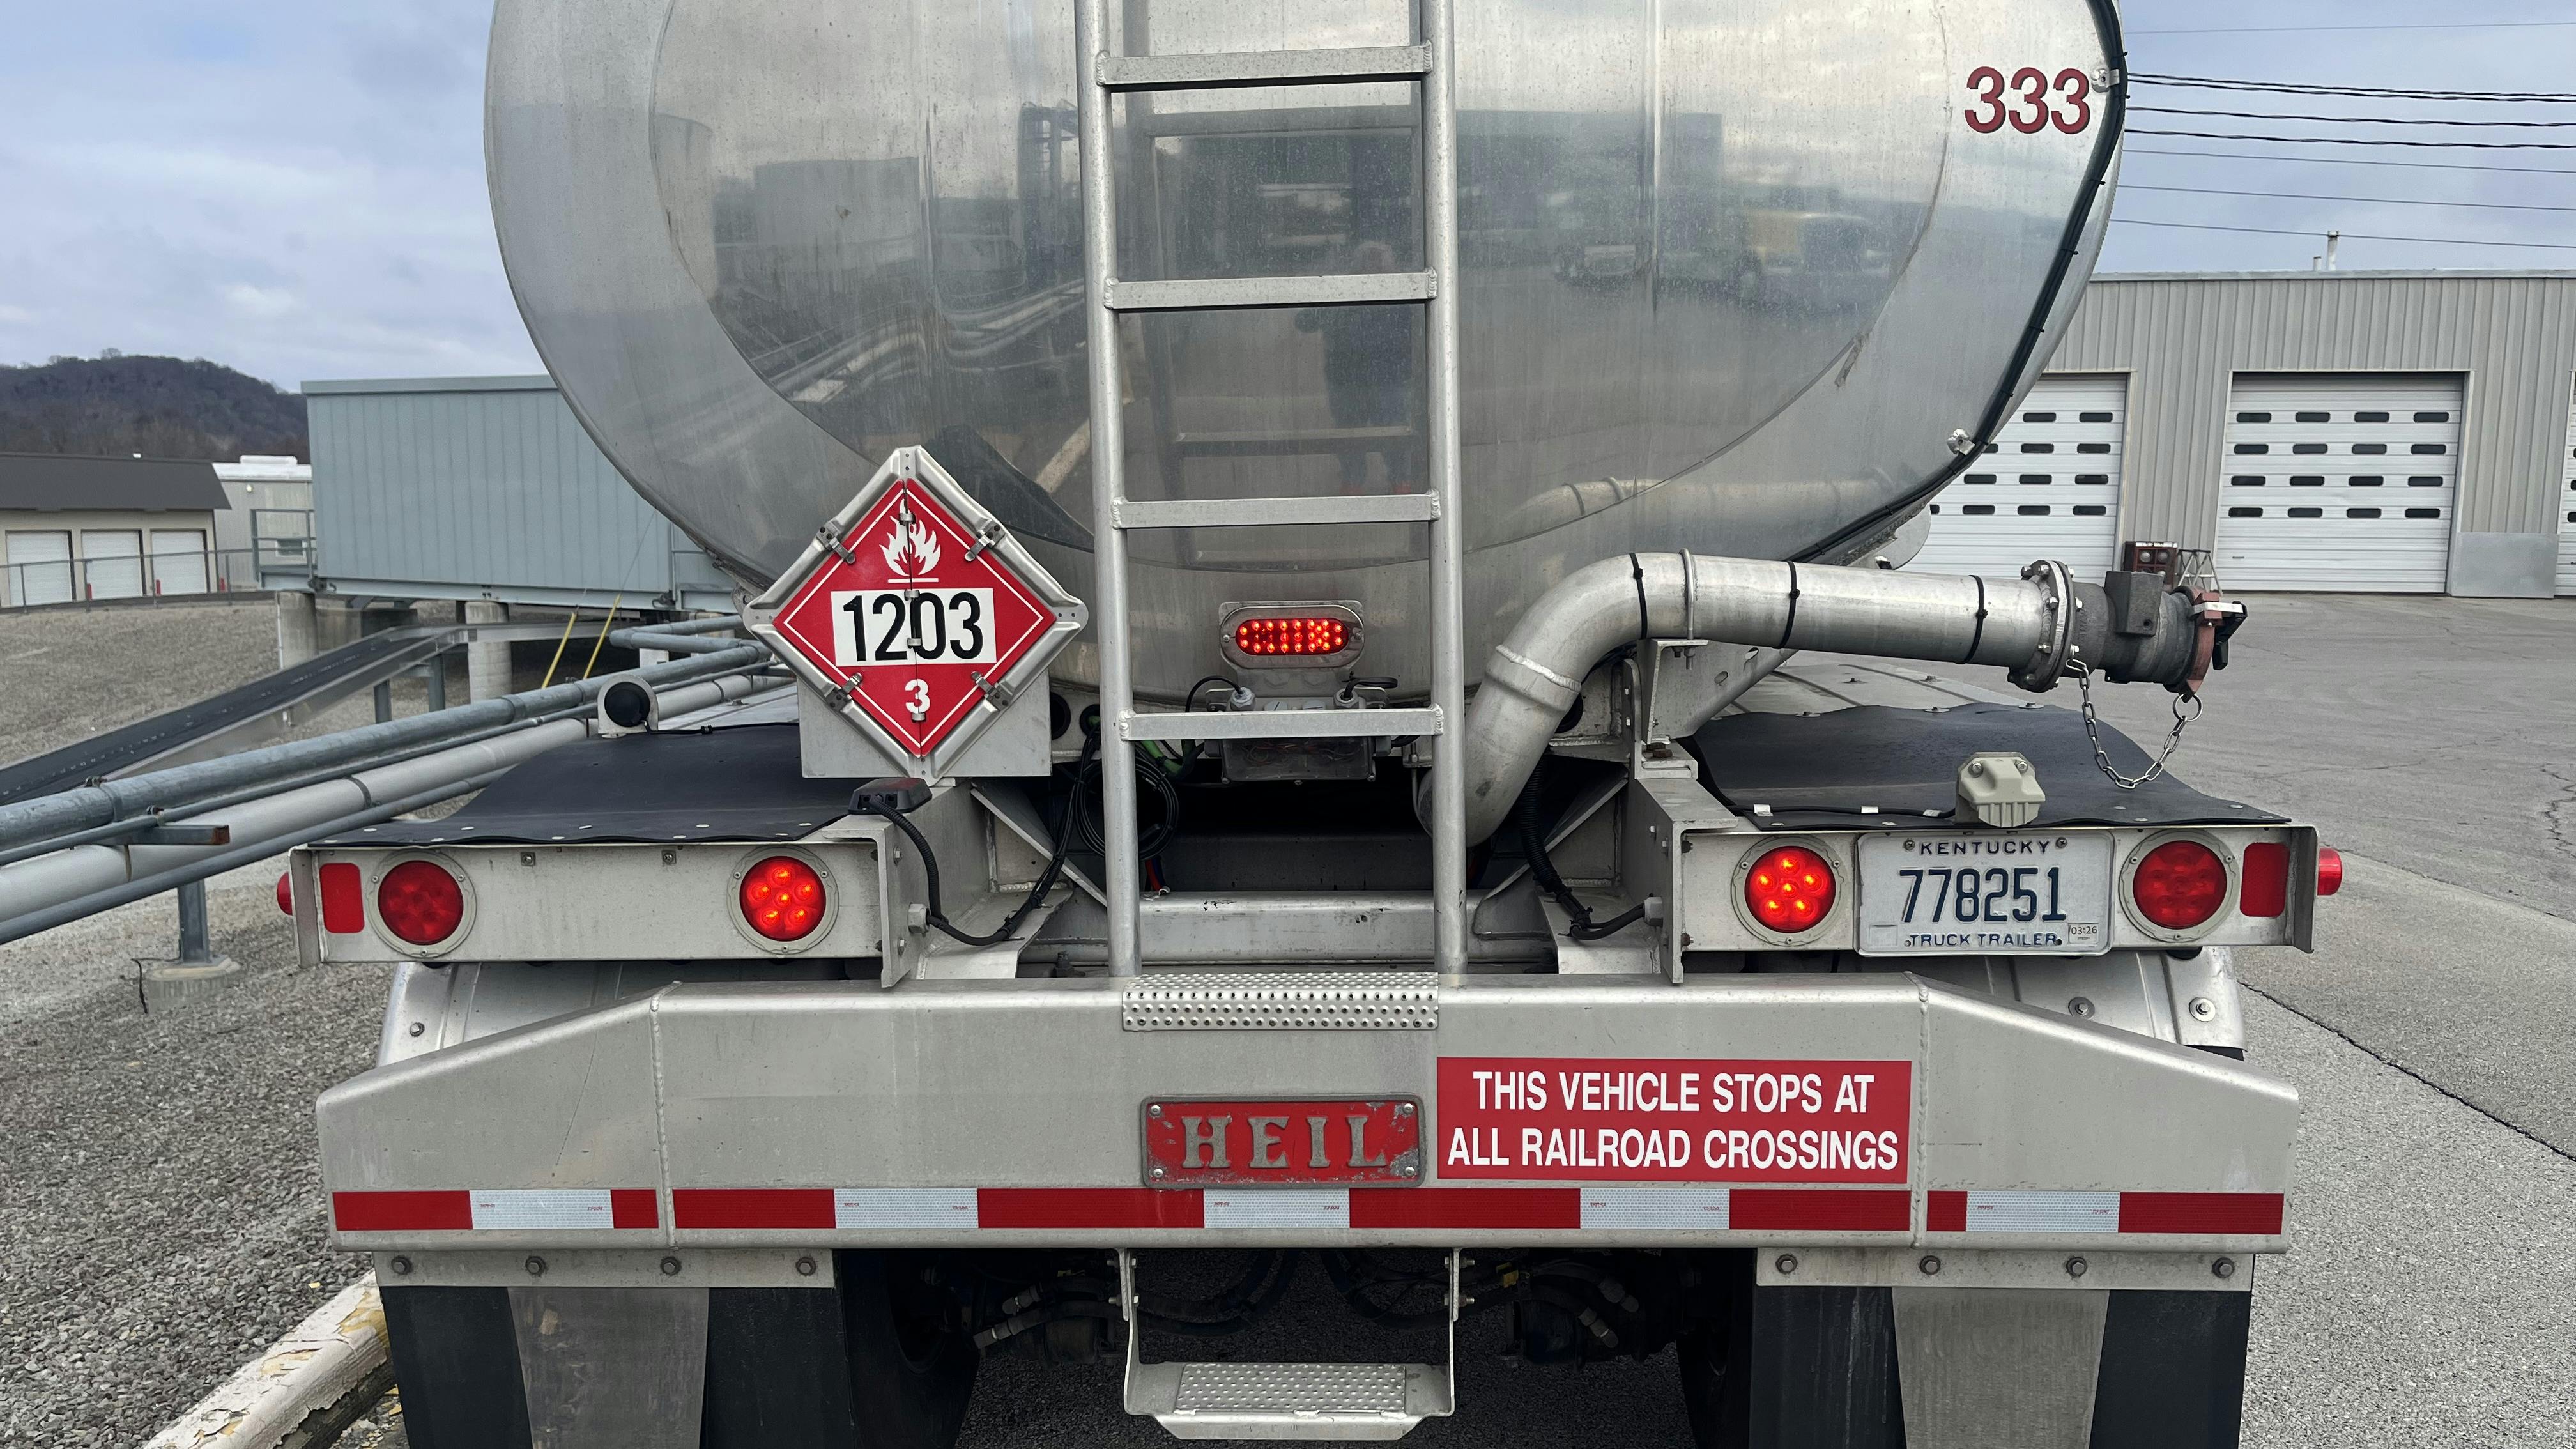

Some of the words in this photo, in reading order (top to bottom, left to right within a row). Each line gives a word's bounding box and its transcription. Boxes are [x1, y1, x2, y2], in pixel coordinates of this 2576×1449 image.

[1965, 66, 2091, 134] 333
[843, 592, 983, 662] 1203
[905, 679, 931, 714] 3
[1920, 840, 2050, 855] KENTUCKY
[1899, 866, 2067, 923] 778251
[1910, 933, 1971, 947] TRUCK
[1977, 933, 2058, 946] TRAILER
[1473, 1071, 1547, 1111] THIS
[1558, 1071, 1700, 1112] VEHICLE
[1713, 1073, 1822, 1114] STOPS
[1834, 1074, 1875, 1114] AT
[1181, 1116, 1387, 1169] HEIL
[1447, 1127, 1510, 1167] ALL
[1522, 1128, 1690, 1169] RAILROAD
[1703, 1130, 1898, 1170] CROSSINGS
